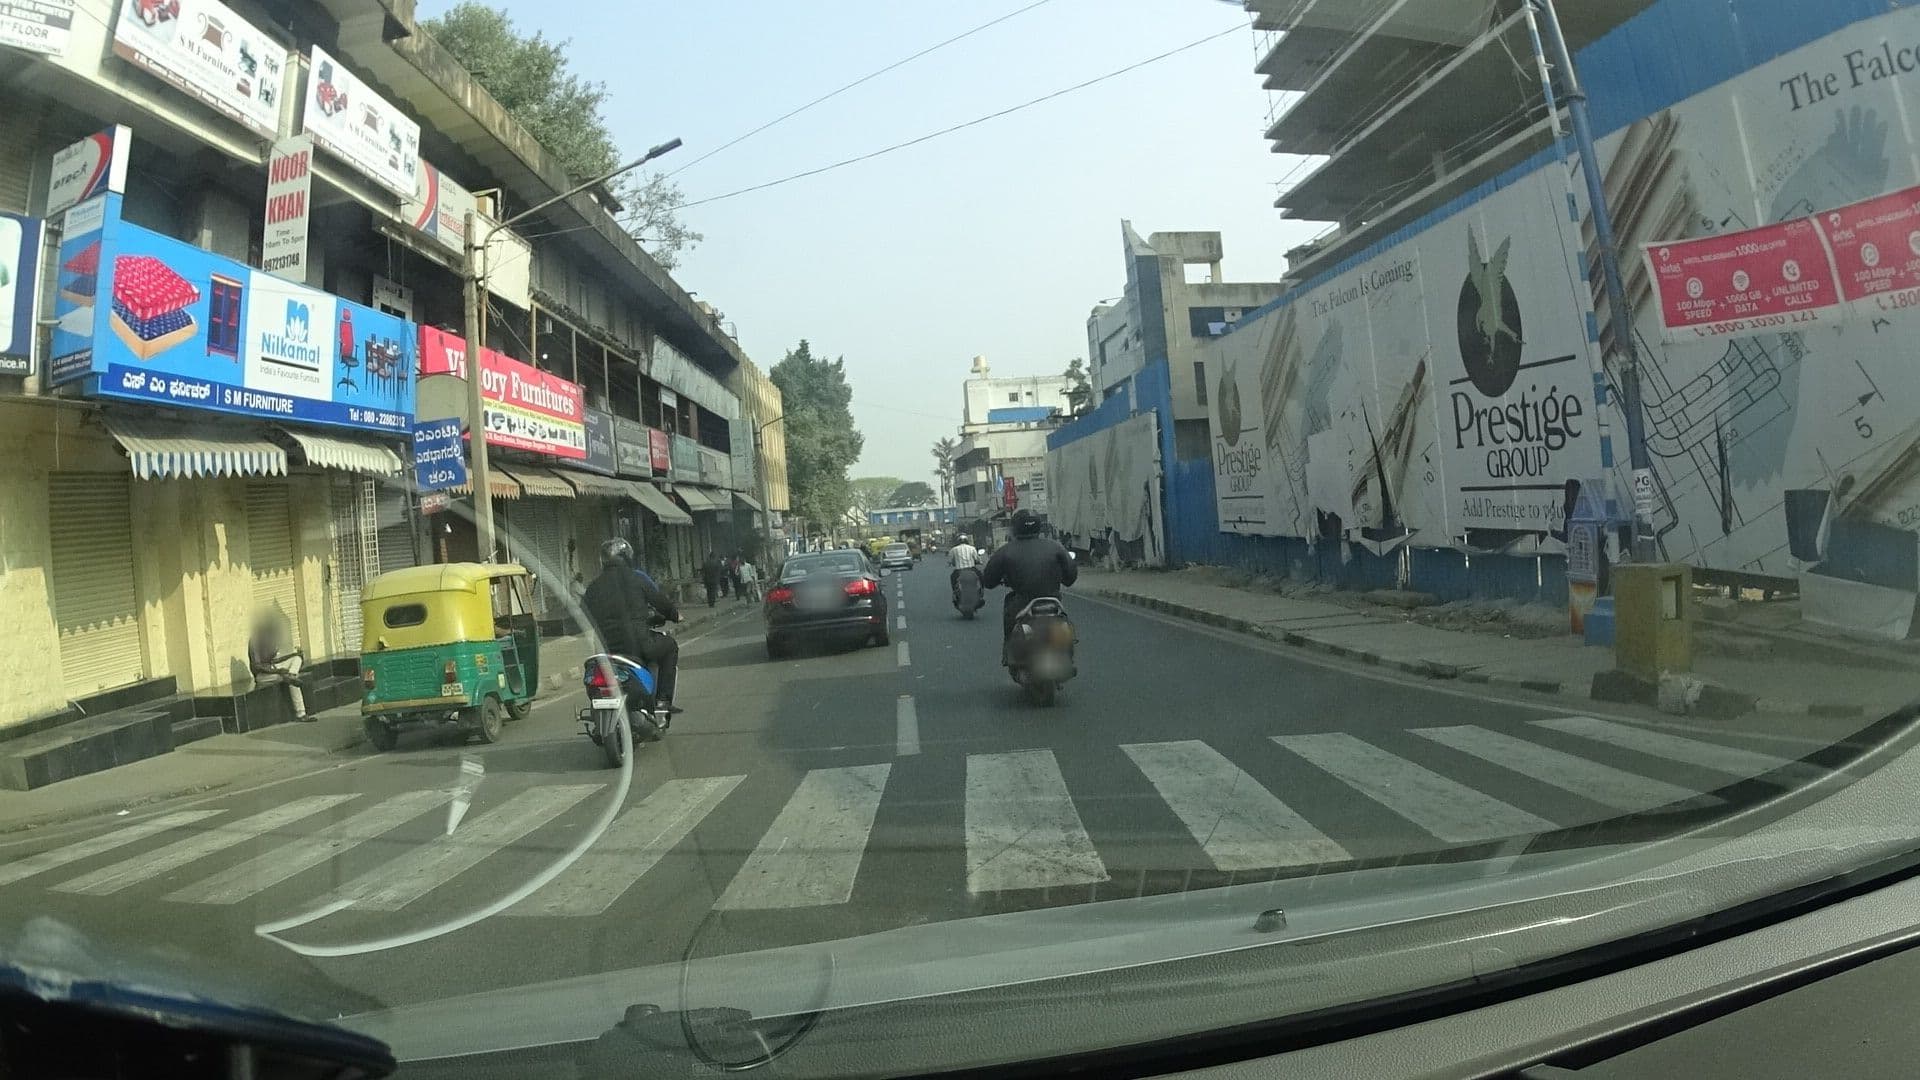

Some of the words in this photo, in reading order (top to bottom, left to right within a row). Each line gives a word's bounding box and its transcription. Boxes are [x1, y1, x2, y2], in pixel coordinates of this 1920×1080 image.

[12, 22, 48, 39] FLOOR
[196, 43, 236, 77] Furniture
[1780, 70, 1840, 112] The
[271, 150, 308, 185] NOOR
[268, 190, 305, 225] KHAN
[1311, 300, 1328, 320] The
[1328, 287, 1359, 310] Falcon
[1360, 277, 1369, 296] Is
[1371, 260, 1413, 283] Coming
[1677, 301, 1692, 312] 100
[1772, 280, 1819, 296] UNLIMITED
[1784, 293, 1814, 306] CALLS
[1684, 308, 1712, 321] SPEED
[1735, 303, 1759, 314] DATA
[1709, 319, 1745, 336] 1800
[262, 332, 320, 365] Nilkamal
[123, 372, 146, 389] ಎಸ್
[149, 377, 166, 393] ಎಂ
[446, 348, 508, 402] Viory
[510, 371, 574, 415] Furnitures
[224, 389, 232, 404] S
[233, 392, 242, 406] M
[243, 393, 293, 413] FURNITURE
[1451, 384, 1583, 450] Prestige
[1855, 416, 1873, 439] 5
[1217, 441, 1261, 477] Prestige
[1487, 446, 1549, 478] GROUP
[1463, 498, 1483, 518] Add
[1485, 498, 1526, 521] Prestige
[1528, 502, 1540, 518] to
